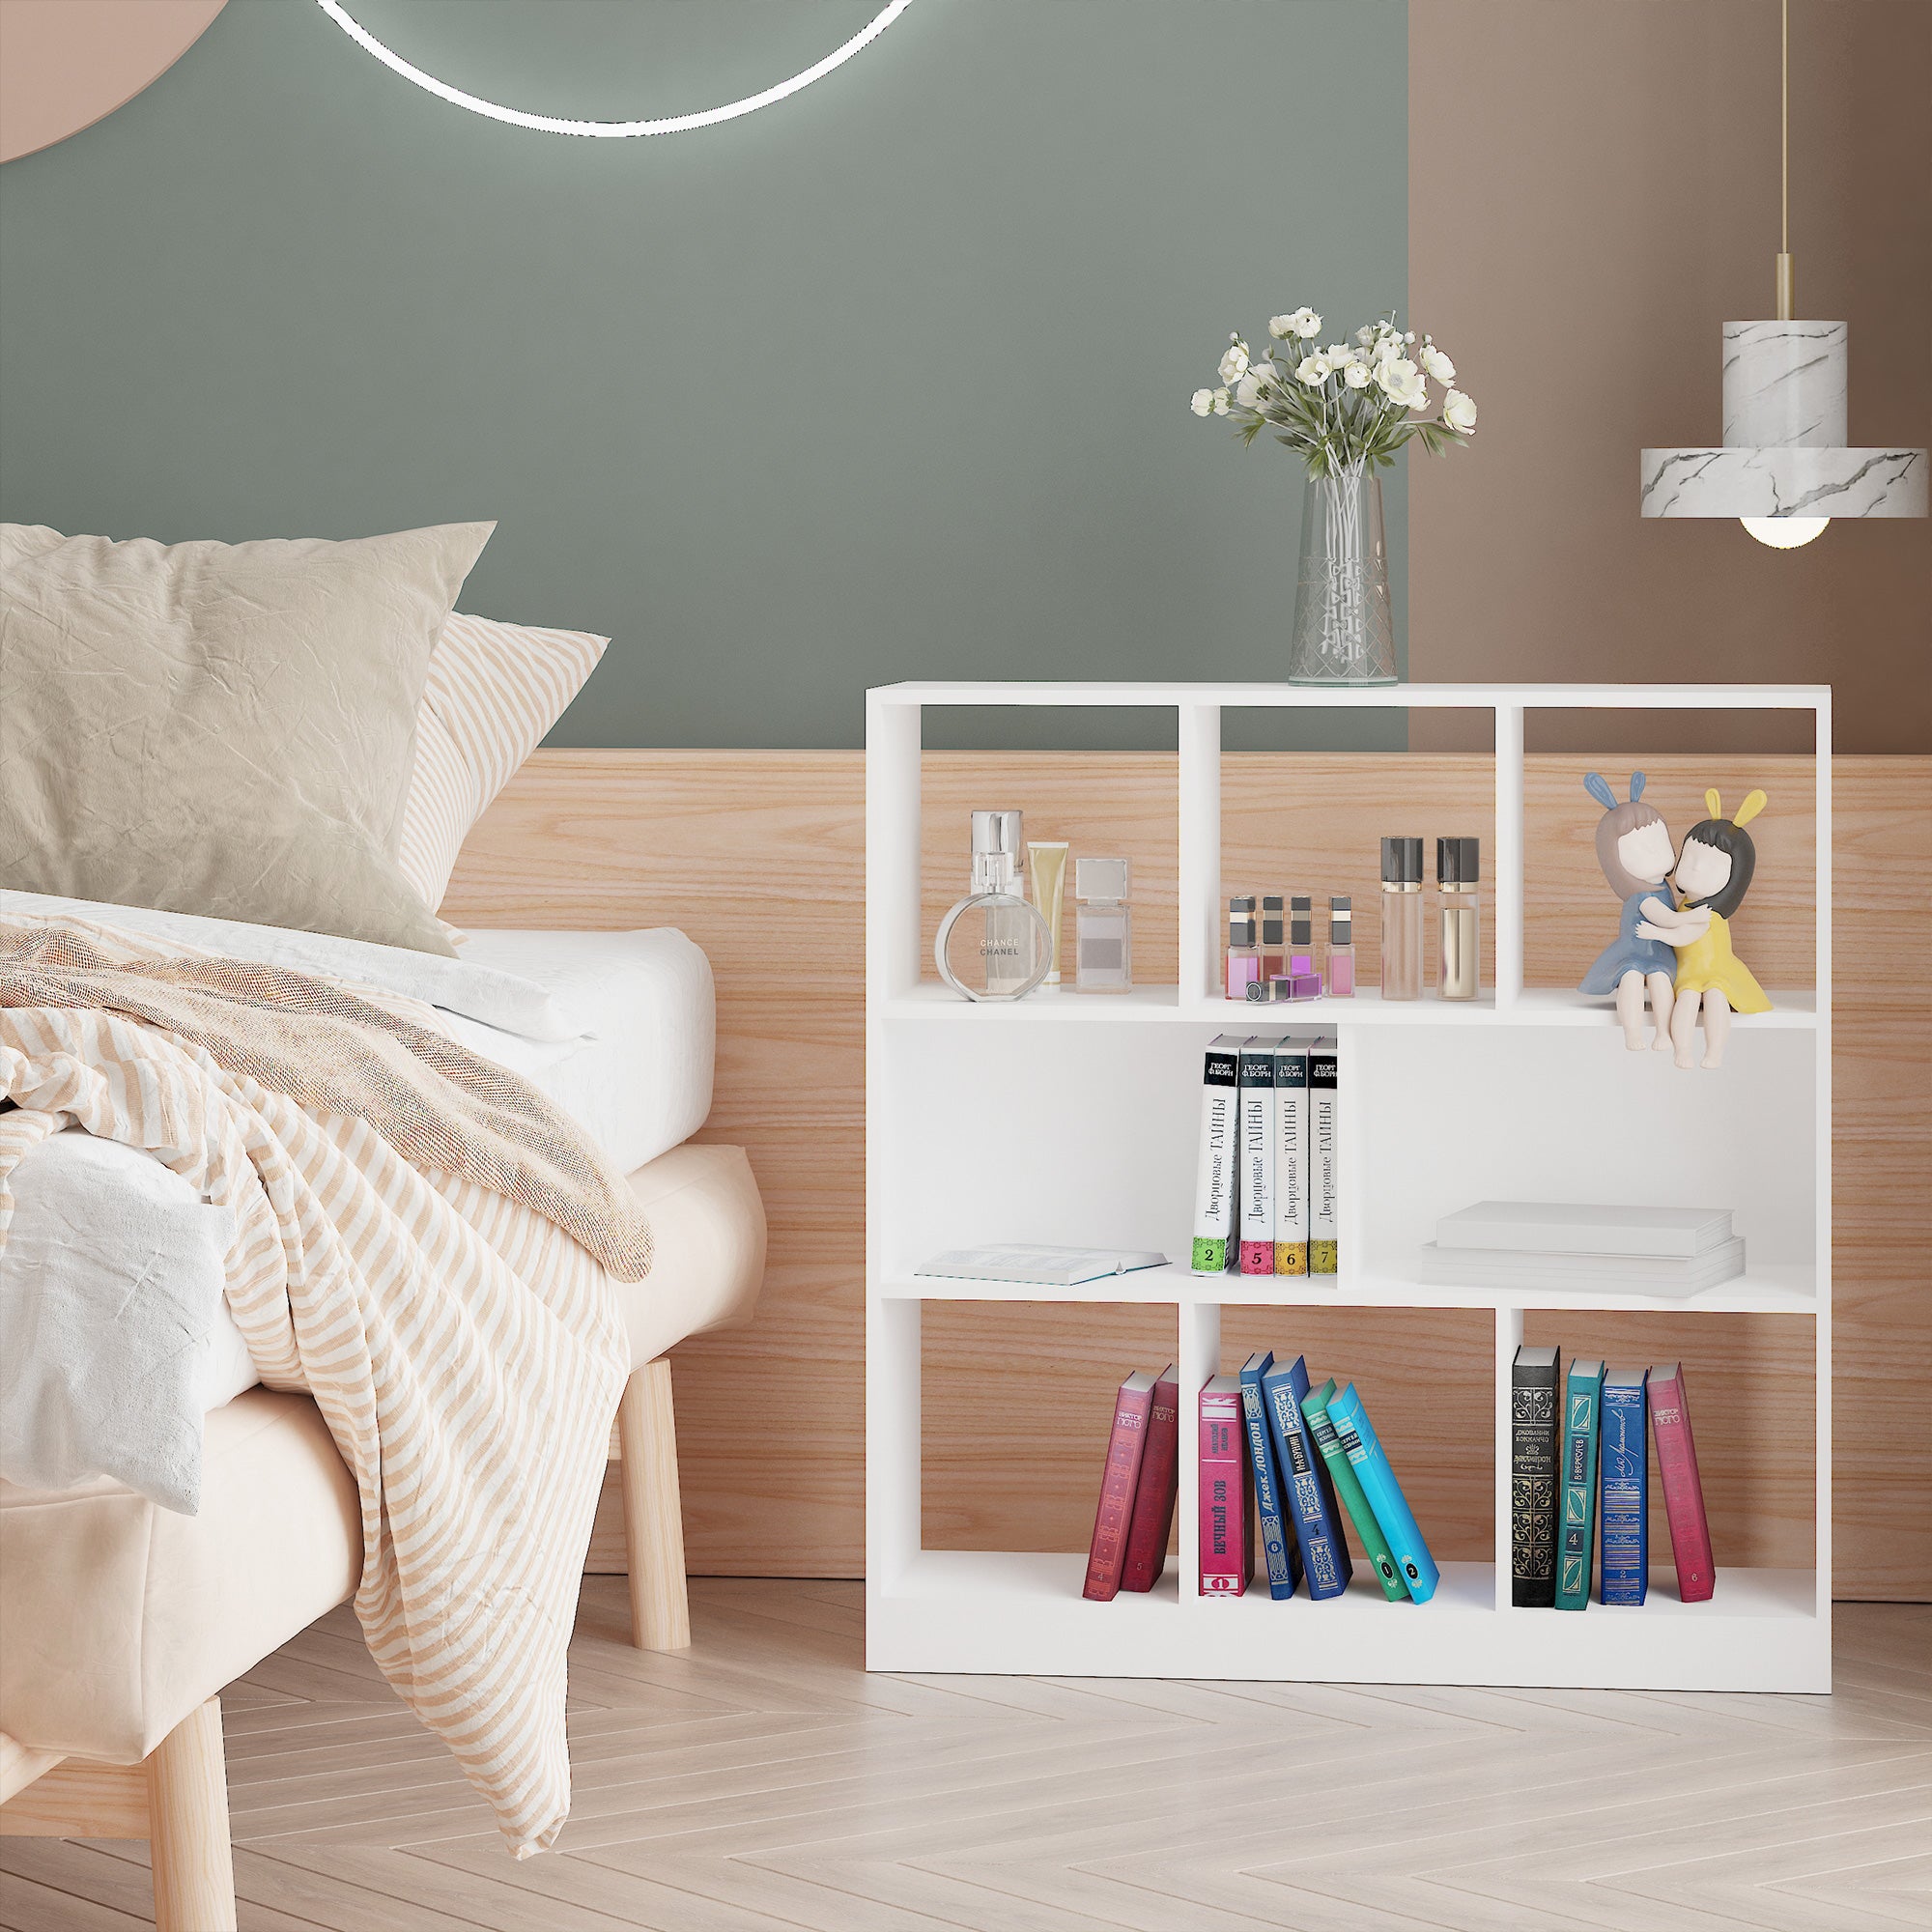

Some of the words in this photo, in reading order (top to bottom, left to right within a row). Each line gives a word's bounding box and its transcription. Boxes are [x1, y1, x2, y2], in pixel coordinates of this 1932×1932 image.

[980, 938, 1019, 947] CHANCE
[1210, 1098, 1226, 1151] ТАЙНЫ
[1246, 1100, 1263, 1153] ТАЙНЫ
[1283, 1100, 1296, 1154] ТАЙНЫ
[1318, 1101, 1332, 1154] ТАЙНЫ
[1206, 1154, 1223, 1221] Дворцовые
[1248, 1156, 1267, 1223] Дворцовые
[1285, 1157, 1300, 1225] Дворцовые
[1320, 1157, 1335, 1223] Дворцовые
[1205, 1249, 1213, 1262] 2
[1252, 1253, 1262, 1264] 5
[1287, 1254, 1296, 1264] 6
[1321, 1252, 1329, 1263] 7
[1250, 1422, 1266, 1475] ЛОНДОН
[1213, 1480, 1227, 1502] ЗОВ
[1261, 1476, 1275, 1513] Джек
[1211, 1506, 1227, 1554] ВЕЧНЫЙ
[1312, 1523, 1321, 1535] 4
[1569, 1533, 1578, 1546] 4
[1270, 1543, 1278, 1552] 6
[1136, 1562, 1143, 1571] 5
[1408, 1567, 1416, 1576] 2
[1619, 1570, 1627, 1578] 2
[1691, 1573, 1698, 1582] 6
[1217, 1578, 1223, 1589] 1
